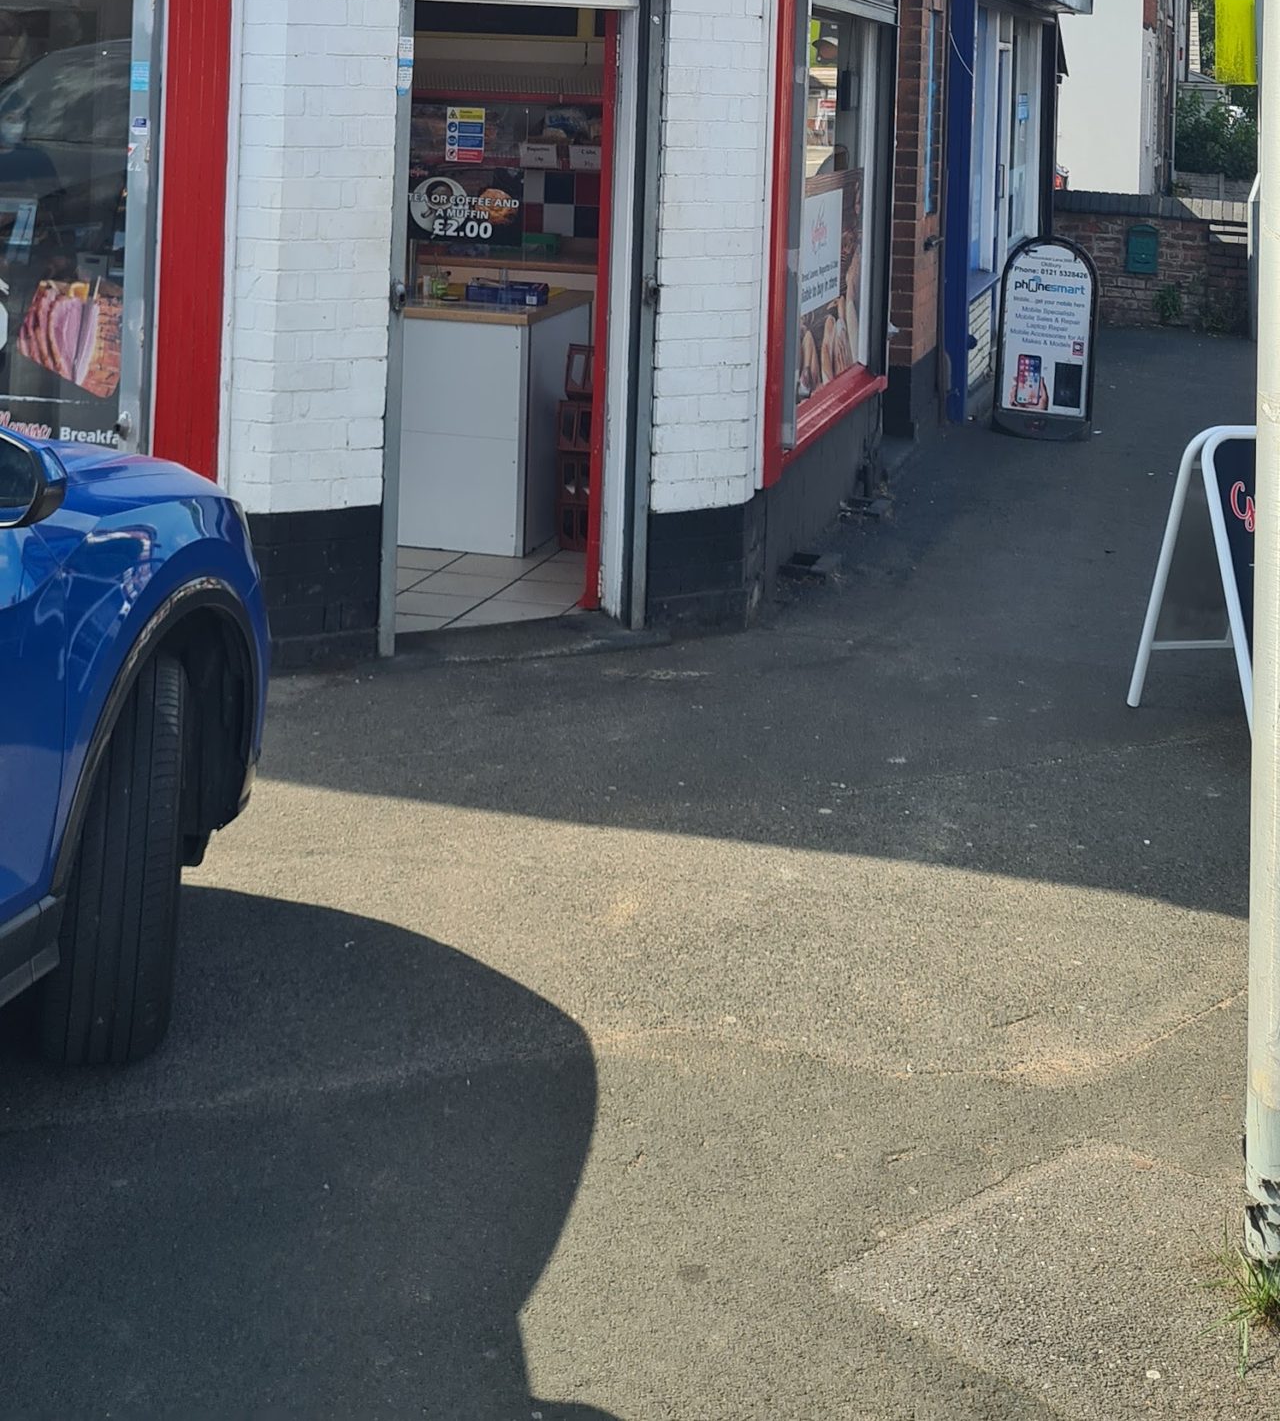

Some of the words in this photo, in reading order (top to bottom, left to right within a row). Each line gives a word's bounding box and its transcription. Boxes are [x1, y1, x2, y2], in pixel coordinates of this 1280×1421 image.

[431, 194, 447, 203] OR
[450, 195, 491, 206] COFFEE
[494, 199, 519, 208] AND
[446, 209, 489, 219] MUFFIN
[433, 219, 492, 239] £2.00
[1014, 266, 1039, 274] Phone:
